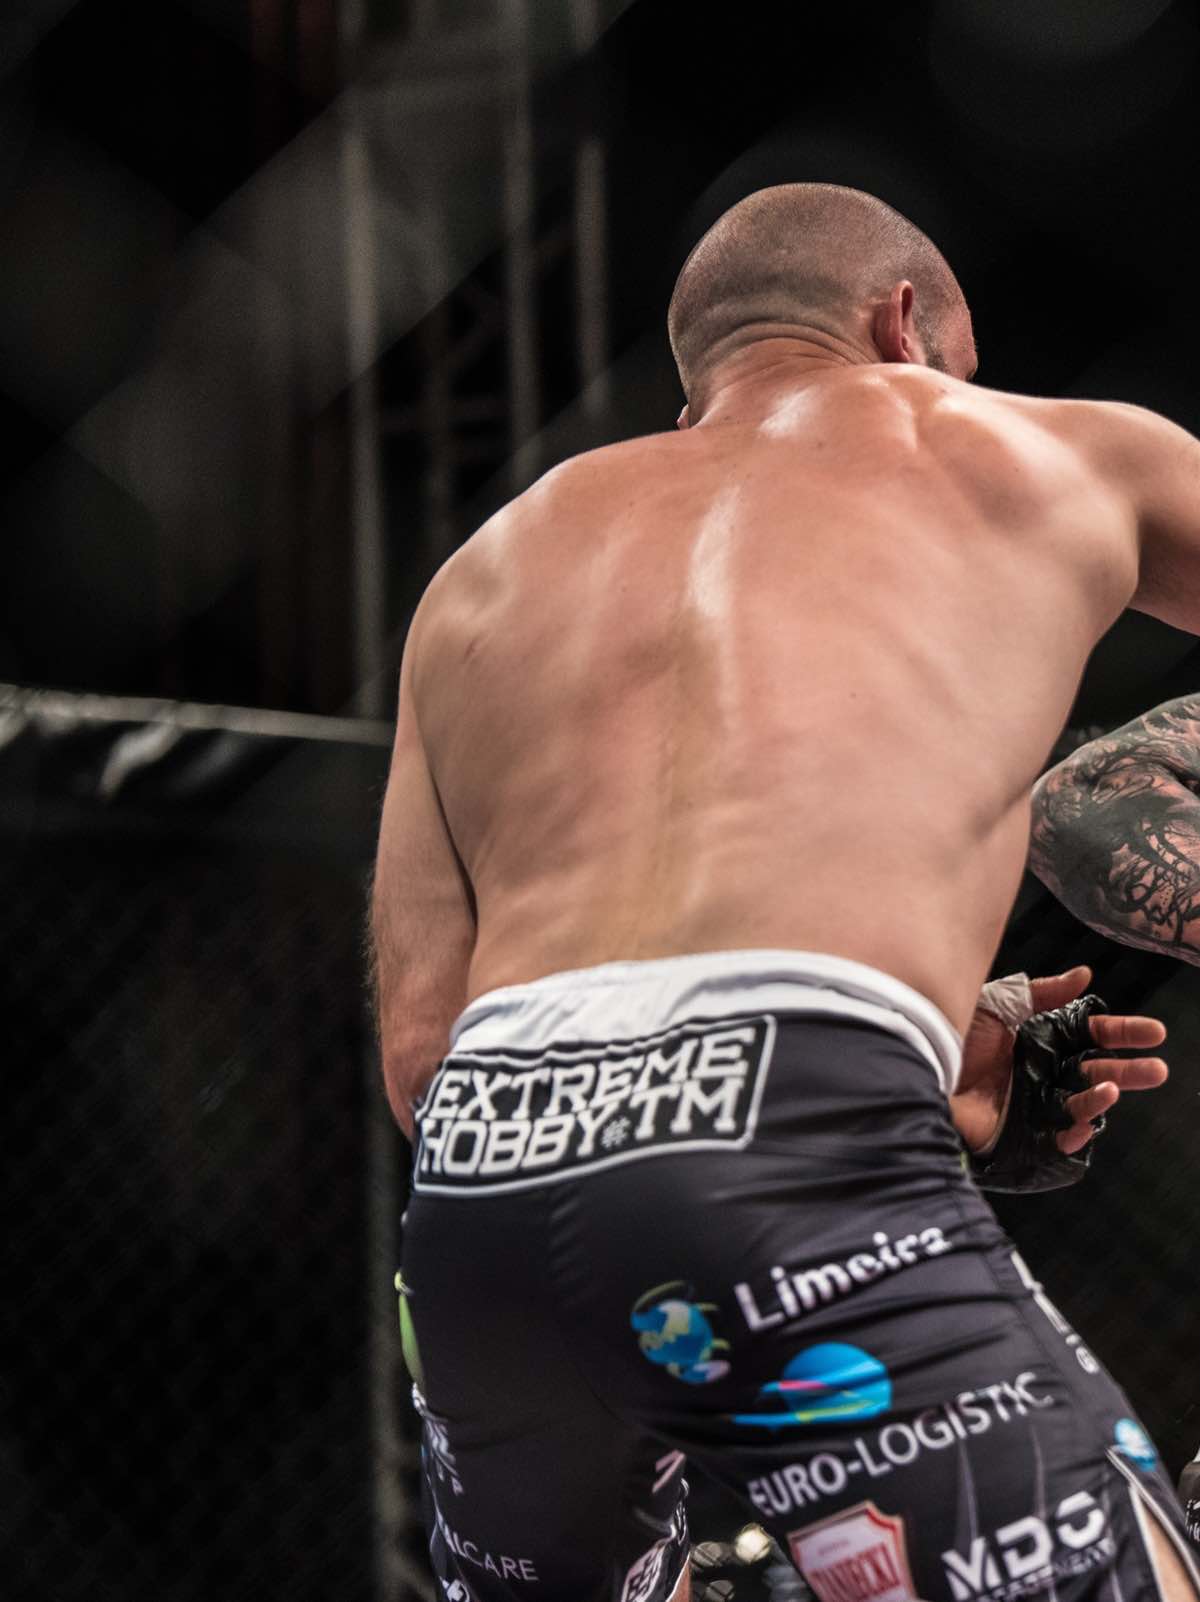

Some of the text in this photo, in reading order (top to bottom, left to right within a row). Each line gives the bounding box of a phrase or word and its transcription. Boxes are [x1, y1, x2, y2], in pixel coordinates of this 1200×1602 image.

[428, 1026, 757, 1121] EXTREME
[419, 1077, 746, 1178] HOBBY TM
[747, 1371, 1056, 1517] EURO-LOGISTIC
